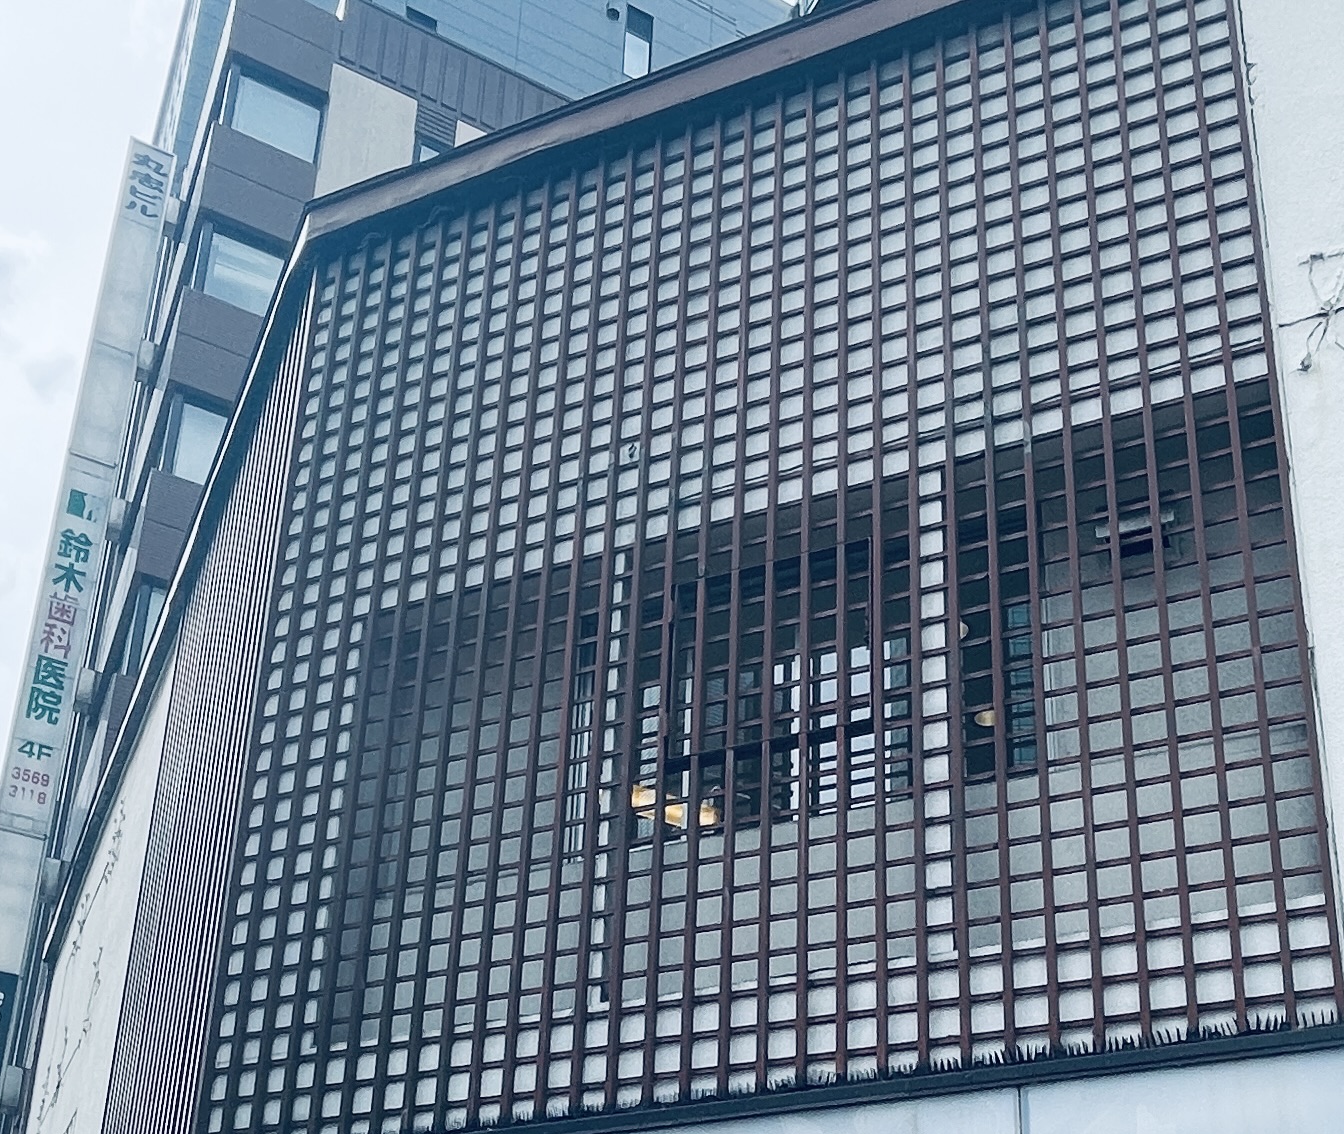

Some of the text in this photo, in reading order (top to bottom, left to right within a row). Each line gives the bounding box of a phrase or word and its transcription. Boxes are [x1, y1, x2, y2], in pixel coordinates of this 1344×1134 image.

[25, 527, 94, 726] 鈴木歯科医院
[17, 740, 54, 761] 4F
[10, 766, 50, 788] 3569
[8, 784, 47, 805] 3118
